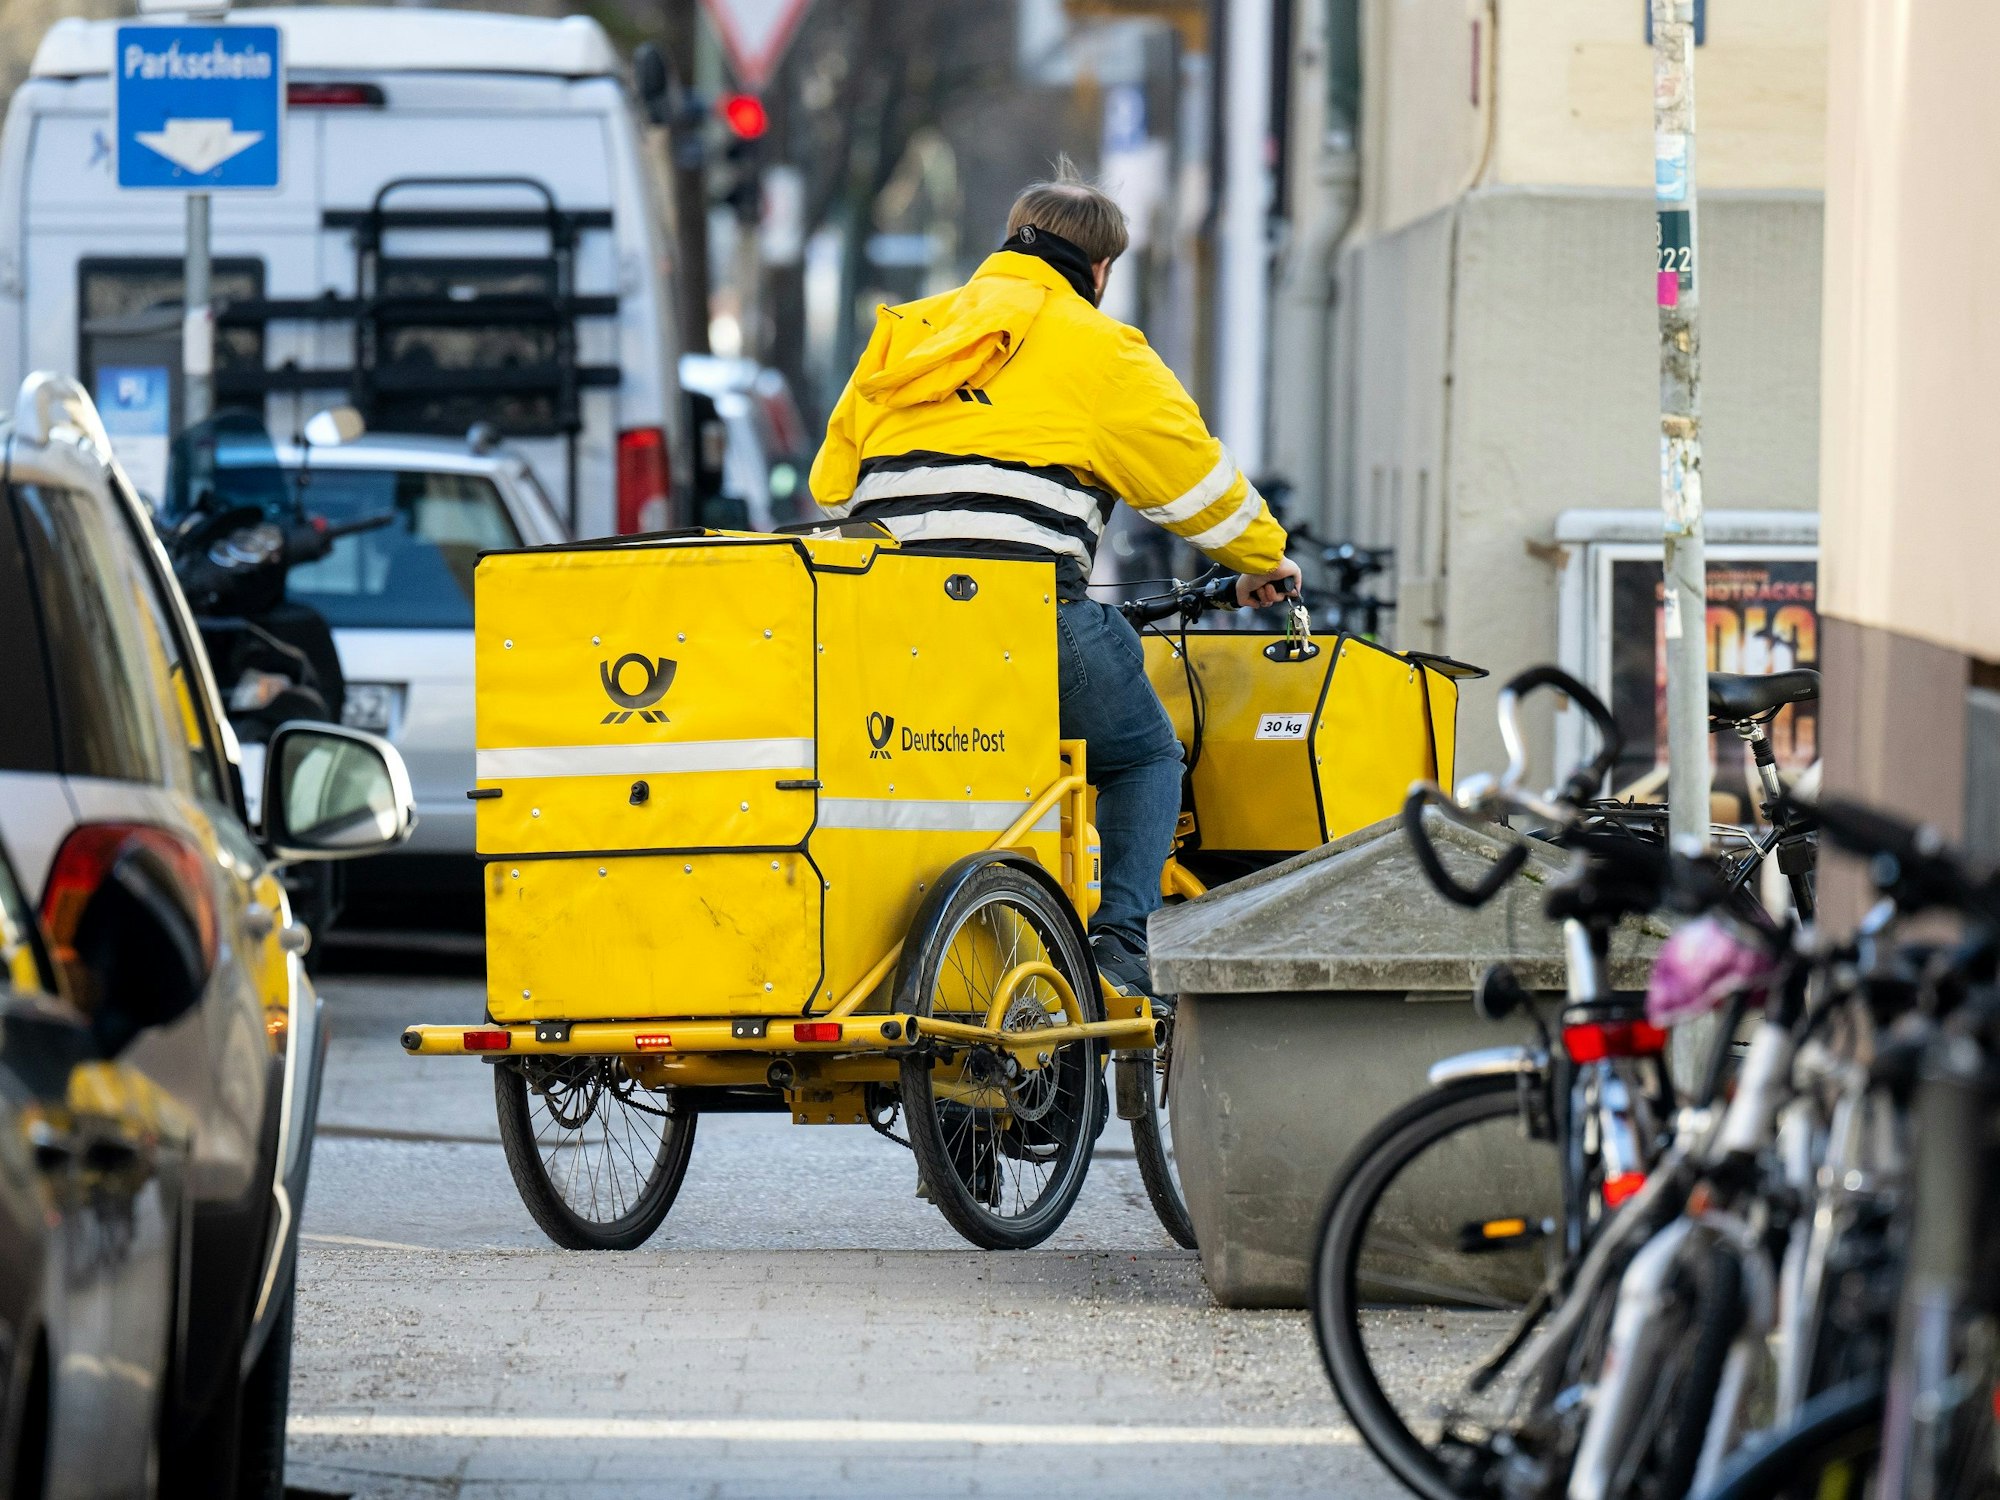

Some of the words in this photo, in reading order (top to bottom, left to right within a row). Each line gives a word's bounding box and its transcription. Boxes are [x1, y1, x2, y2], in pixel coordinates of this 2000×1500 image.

[124, 39, 272, 80] Parkschein
[901, 725, 969, 752] Deutsche
[972, 727, 1005, 752] Post
[1264, 721, 1282, 732] 30
[1285, 720, 1303, 734] kg
